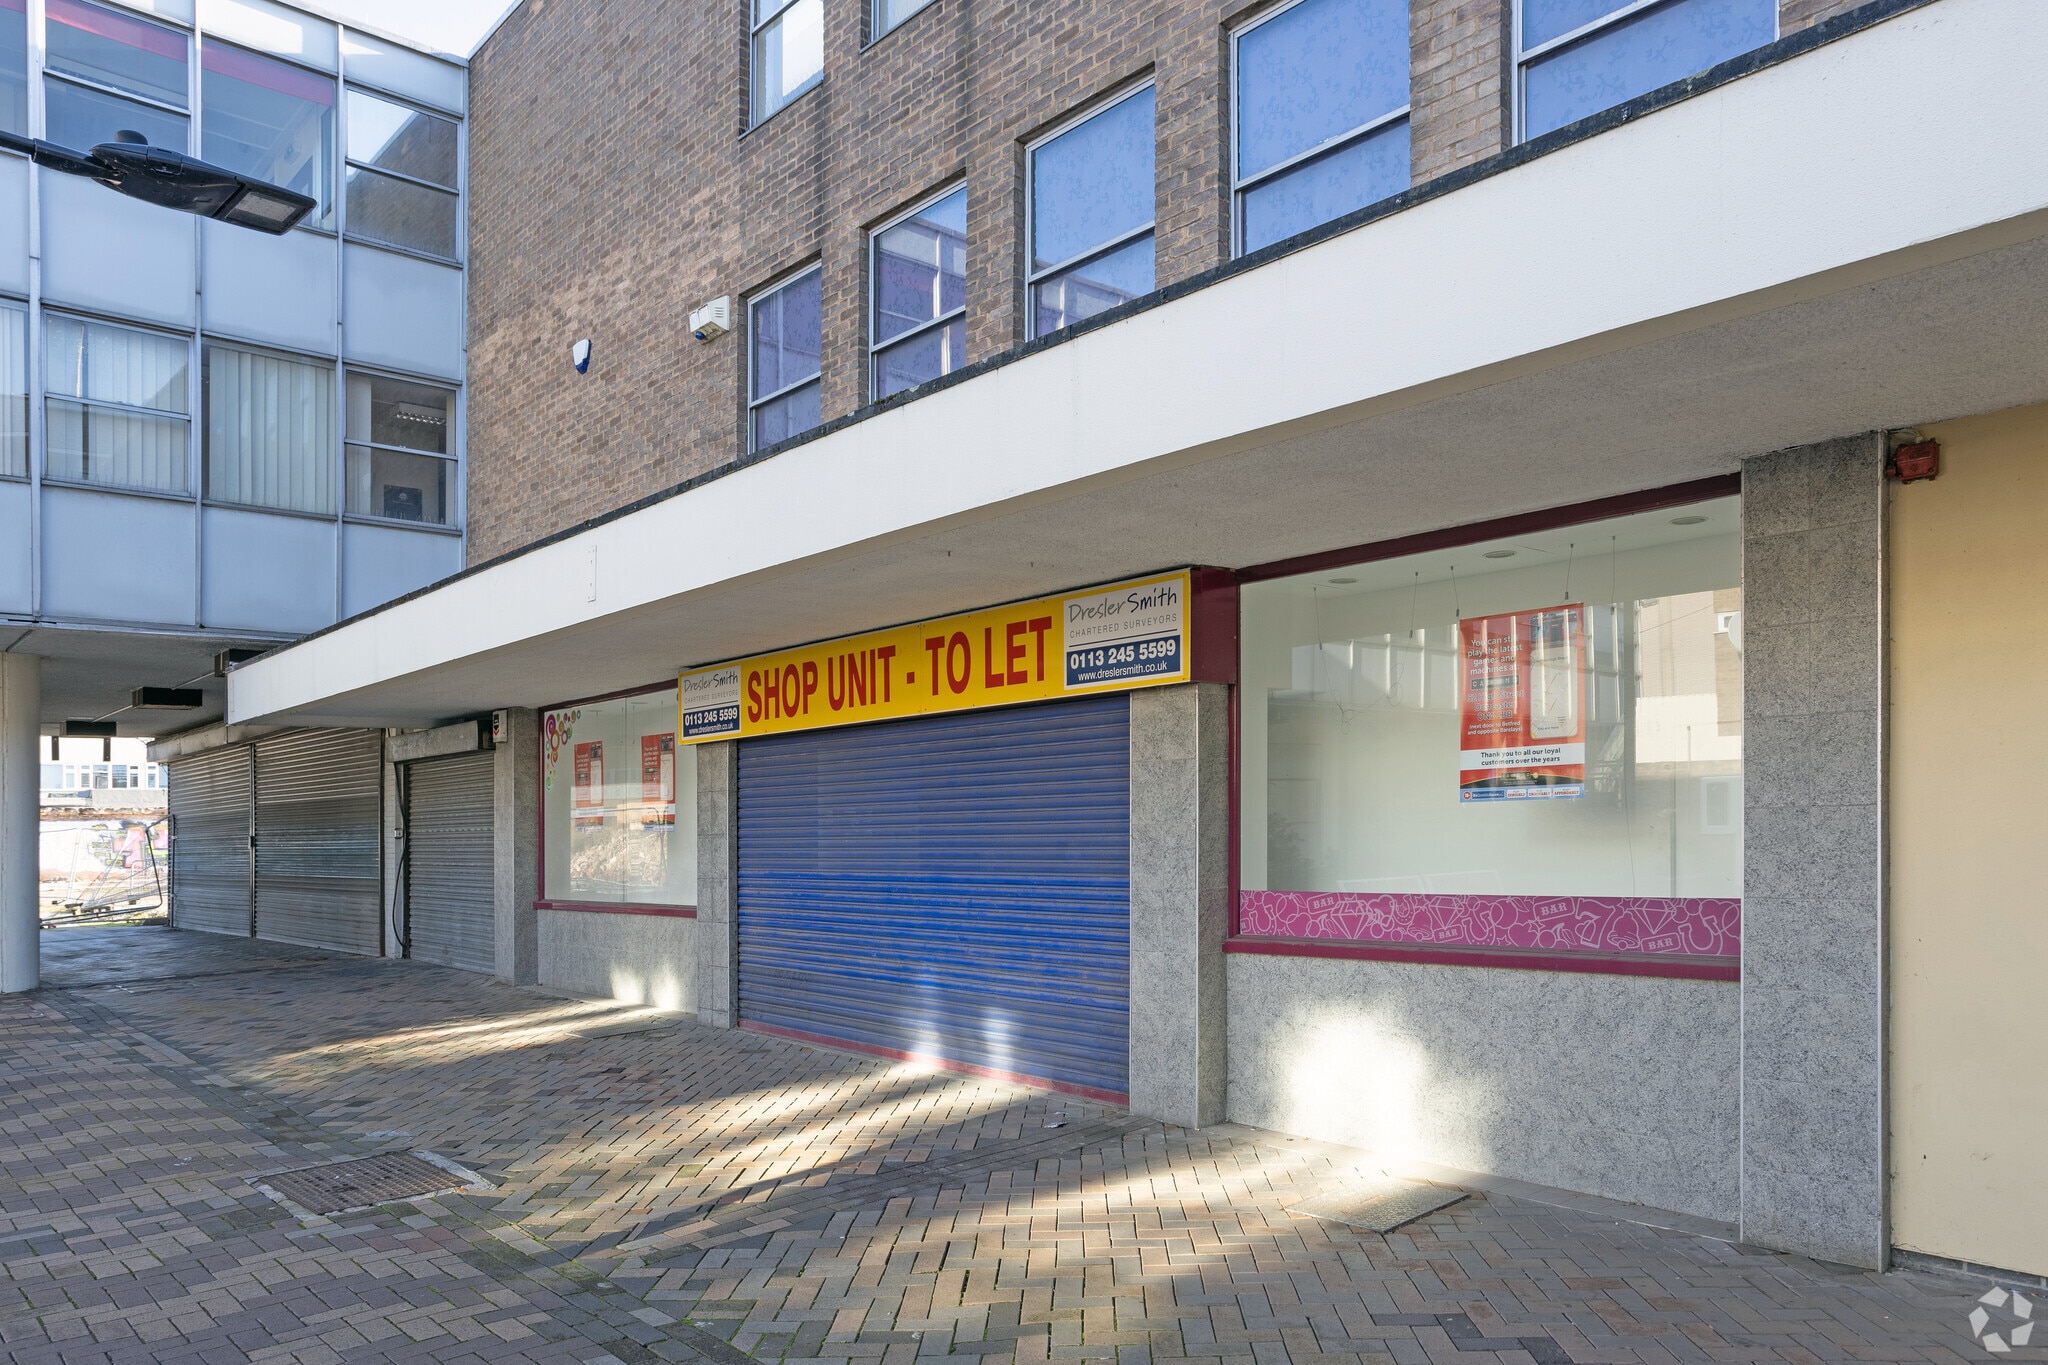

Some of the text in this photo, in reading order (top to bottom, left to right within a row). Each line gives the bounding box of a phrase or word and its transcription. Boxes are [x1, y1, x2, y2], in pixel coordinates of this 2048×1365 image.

[1069, 587, 1177, 622] Dresler Smith
[1070, 614, 1177, 638] CHARTERED SURVEYORS
[1488, 637, 1502, 645] can
[1070, 639, 1176, 670] 0113 245 5599
[1468, 648, 1483, 659] play
[748, 660, 818, 723] SHOP
[828, 644, 896, 712] UNIT
[926, 631, 970, 696] TO
[984, 616, 1052, 689] LET
[1078, 660, 1168, 681] www.dreslersmith.co.uk
[684, 670, 738, 692] Dresler Smith
[684, 707, 738, 726] 0113 245 5599
[1544, 748, 1560, 756] loyal
[1312, 896, 1334, 909] BAR
[1540, 902, 1568, 916] BAR
[1438, 928, 1458, 939] BAR
[1648, 938, 1674, 950] BAR
